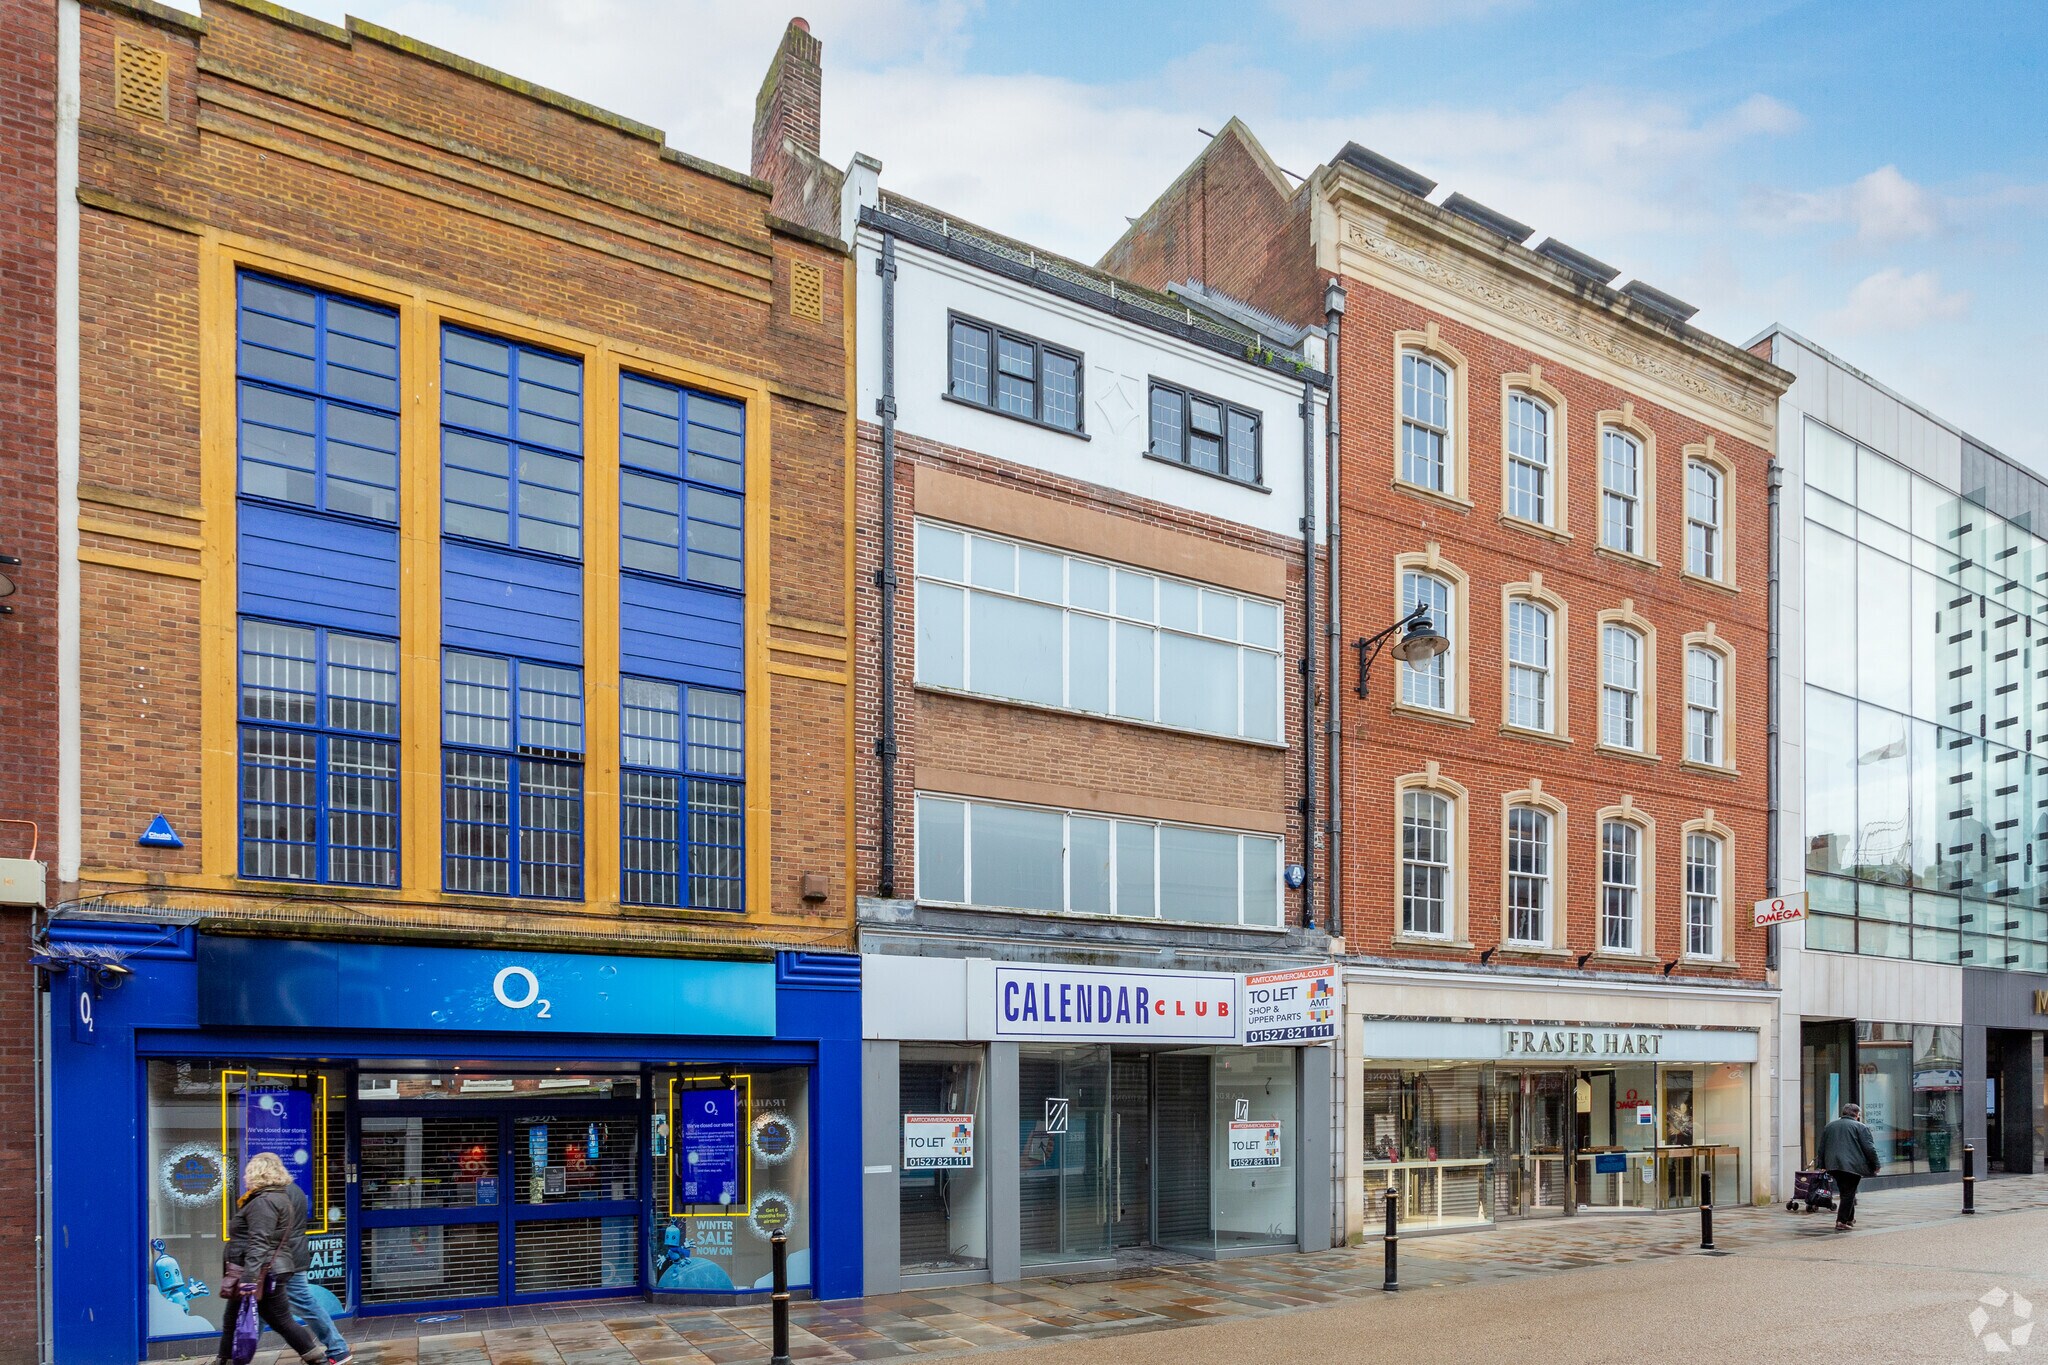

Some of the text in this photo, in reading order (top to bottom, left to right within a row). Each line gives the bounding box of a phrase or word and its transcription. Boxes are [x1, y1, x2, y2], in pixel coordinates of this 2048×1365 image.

[1756, 908, 1802, 924] OMEGA
[1251, 969, 1329, 984] AMTCOMMERCIAL.CO.UK
[493, 966, 552, 1018] O2
[1249, 987, 1298, 1004] TO LET
[1004, 981, 1229, 1024] CALENDAR CLUB
[1310, 998, 1330, 1008] AMT
[1249, 1006, 1271, 1015] SHOP
[1249, 1013, 1301, 1024] UPPER PARTS
[1251, 1025, 1330, 1041] 01527 821 111
[1506, 1030, 1663, 1054] FRASER HART
[704, 1100, 719, 1116] O2
[909, 1137, 945, 1147] TO LET
[1232, 1141, 1260, 1150] TO LET
[910, 1157, 968, 1166] 01527 821 111
[1233, 1157, 1277, 1166] 01527 821 111
[696, 1220, 733, 1230] WINTER
[696, 1230, 733, 1246] SALE
[696, 1247, 733, 1256] NOW ON
[310, 1250, 343, 1268] ALE
[307, 1267, 342, 1280] OW ON
